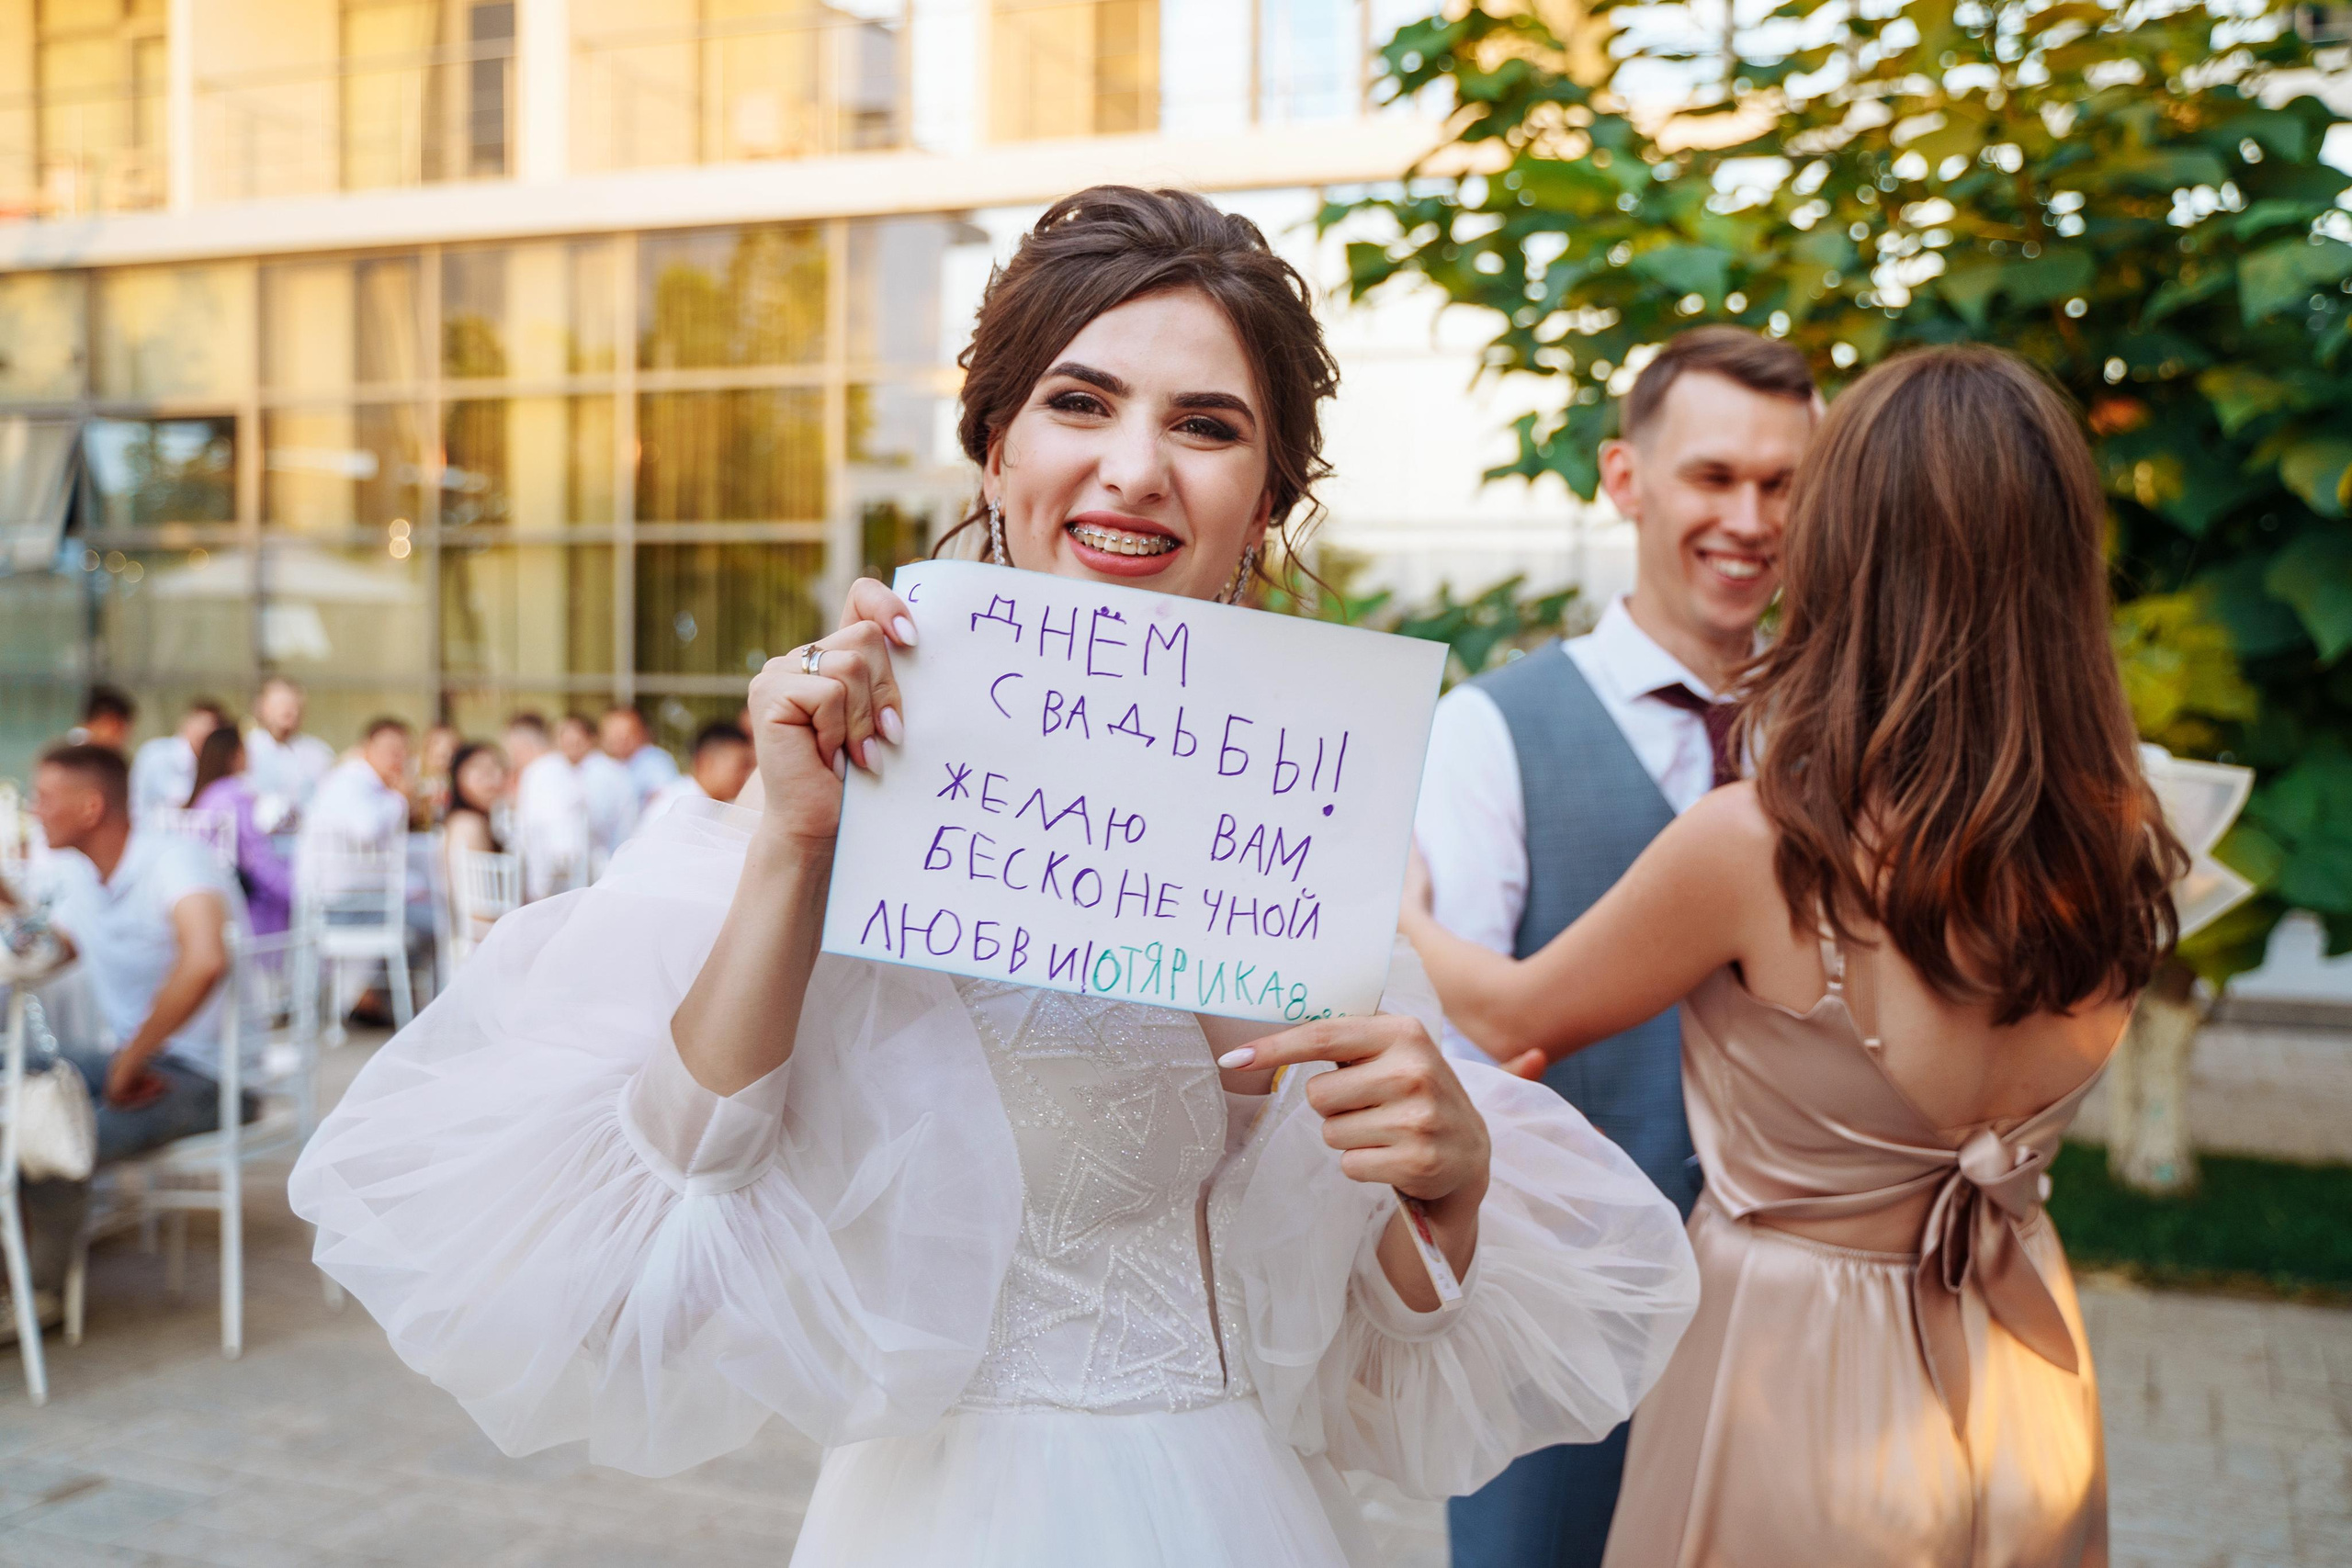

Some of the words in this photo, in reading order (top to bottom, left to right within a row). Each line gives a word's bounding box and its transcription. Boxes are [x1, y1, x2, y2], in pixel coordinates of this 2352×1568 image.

[970, 593, 1189, 688] ДНЁМ
[935, 761, 1147, 851] ЖЕЛАЮ
[1209, 813, 1312, 883] ВАМ
